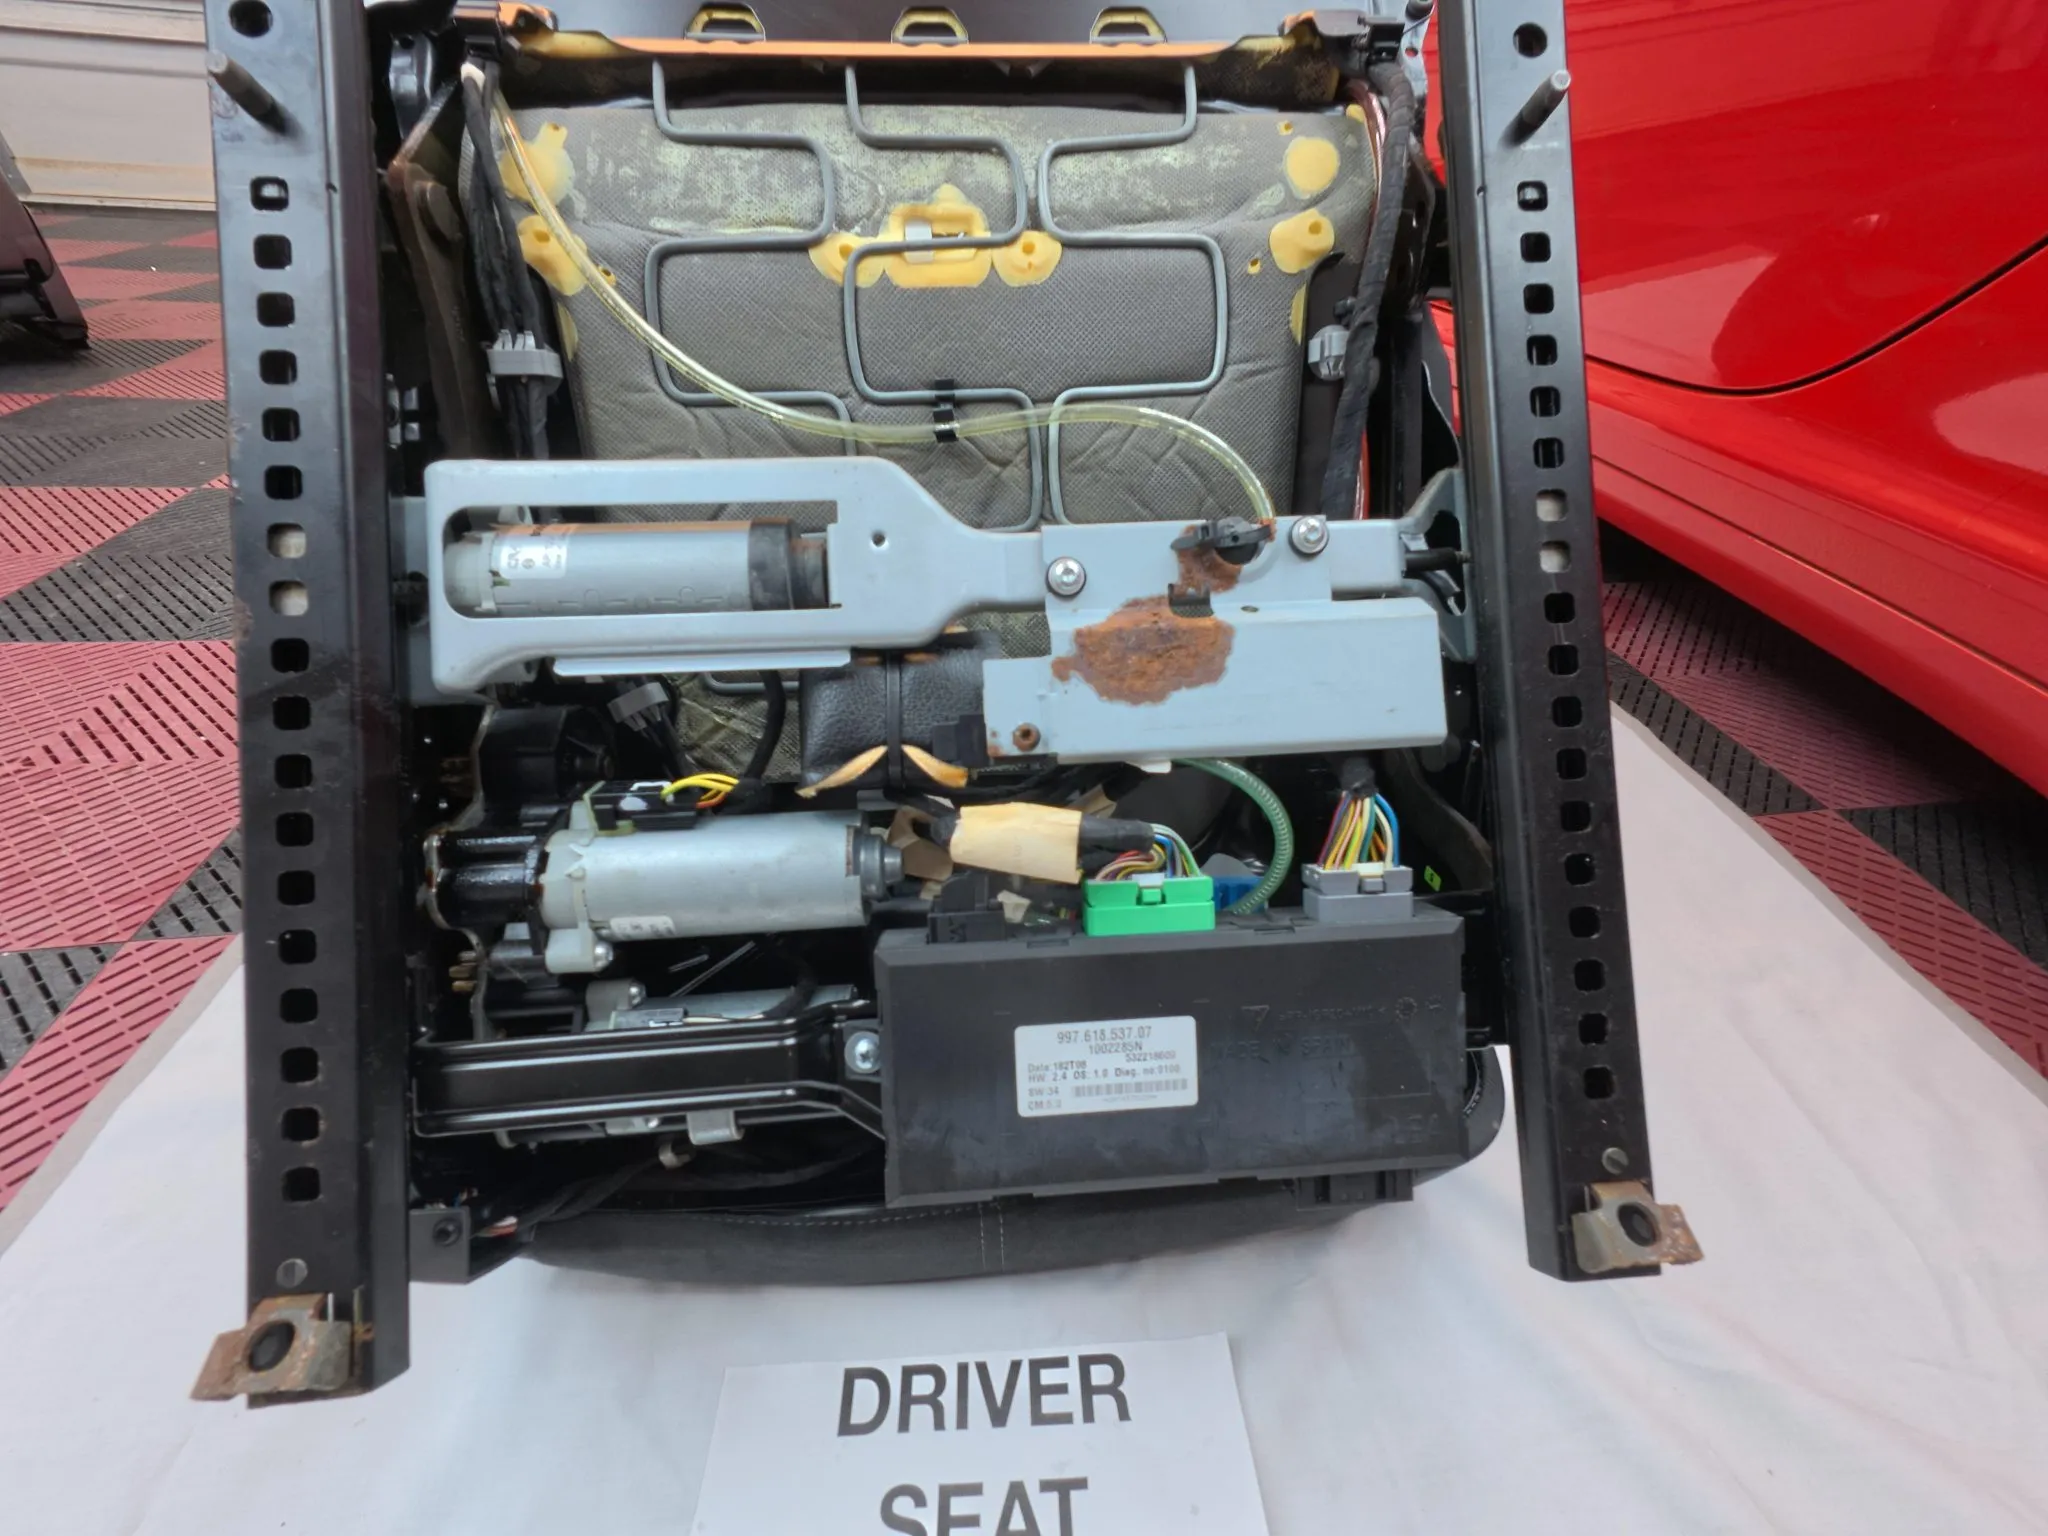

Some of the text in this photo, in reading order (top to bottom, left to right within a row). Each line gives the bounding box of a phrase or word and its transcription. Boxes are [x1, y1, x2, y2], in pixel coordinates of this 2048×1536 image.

[1057, 1026, 1152, 1044] 997.618.537.07
[1089, 1041, 1143, 1055] 1002285N
[837, 1353, 1132, 1437] DRIVER
[880, 1476, 1088, 1536] SEAT
